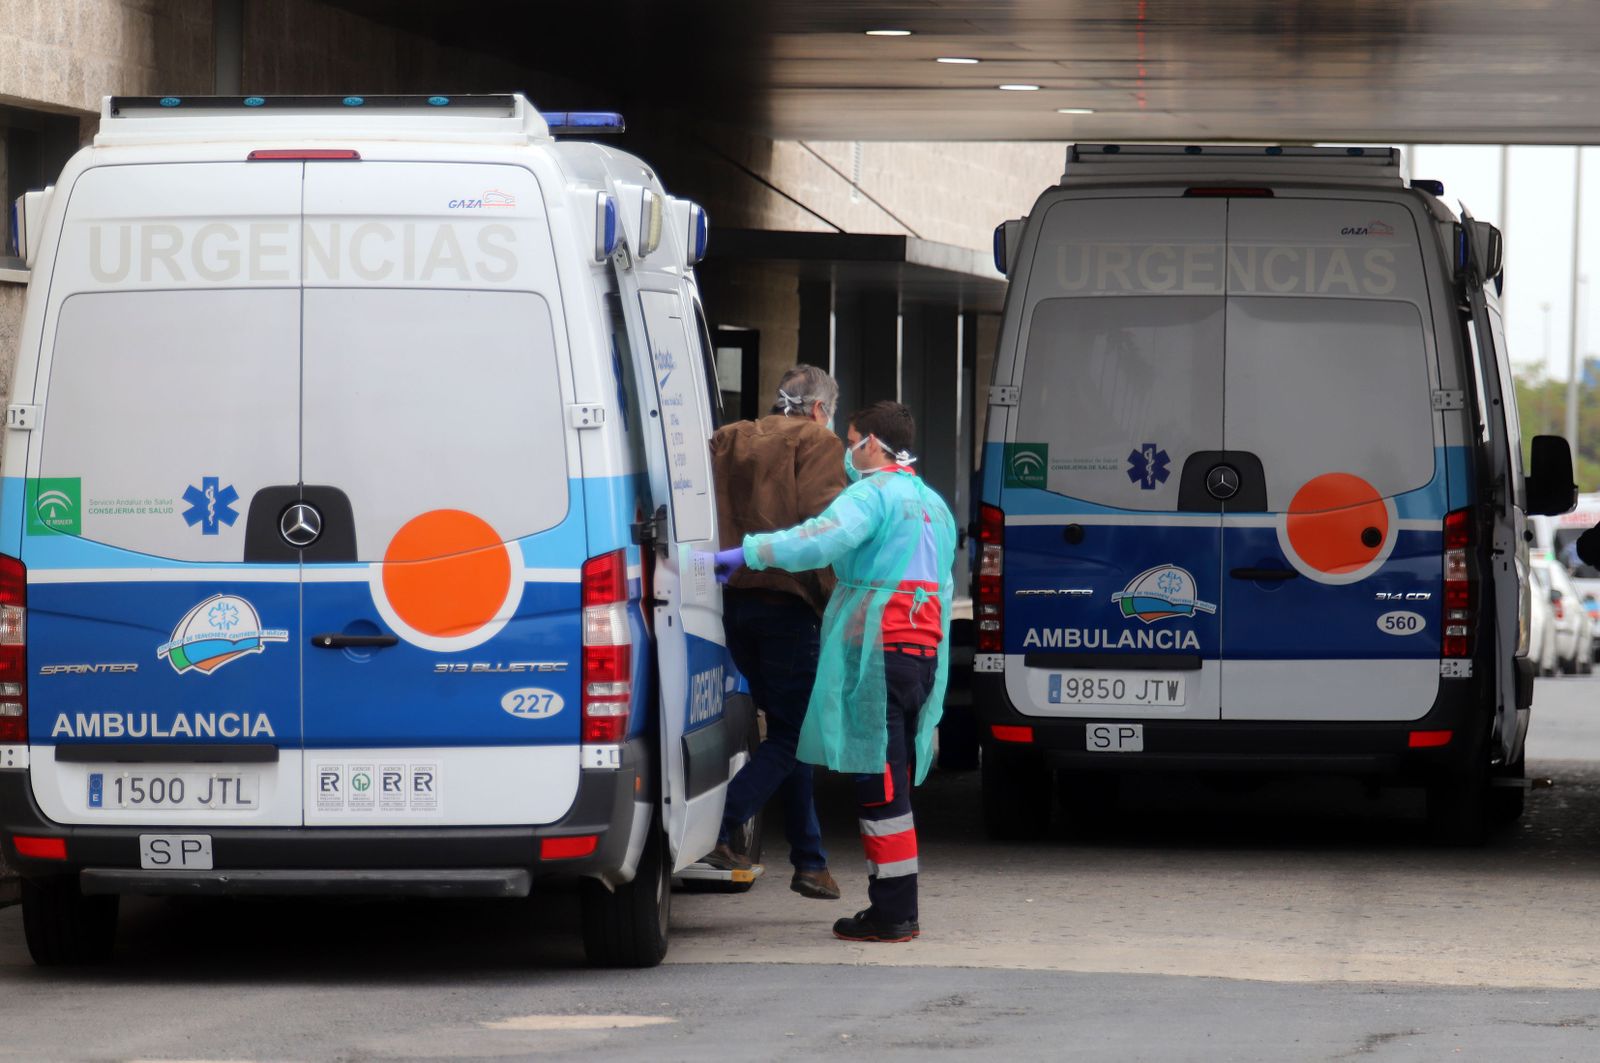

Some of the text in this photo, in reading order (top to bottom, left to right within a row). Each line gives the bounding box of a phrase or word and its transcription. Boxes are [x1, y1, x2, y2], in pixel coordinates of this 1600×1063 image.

[448, 199, 482, 209] GAZA
[1341, 227, 1368, 236] GAZA
[89, 222, 518, 284] URGENCIAS
[1056, 242, 1397, 295] URGENCIAS
[155, 498, 173, 506] Salud
[88, 507, 135, 515] CONSEJERIA
[1375, 592, 1403, 600] 314
[1385, 616, 1417, 630] 560
[1022, 628, 1201, 649] AMBULANCIA
[39, 663, 139, 675] SPRINTER
[433, 662, 569, 673] 313 BLUETEC
[1066, 678, 1180, 701] 9850 JTW
[512, 694, 554, 713] 227
[51, 713, 276, 737] AMBULANCIA
[114, 777, 252, 804] 1500 JTL
